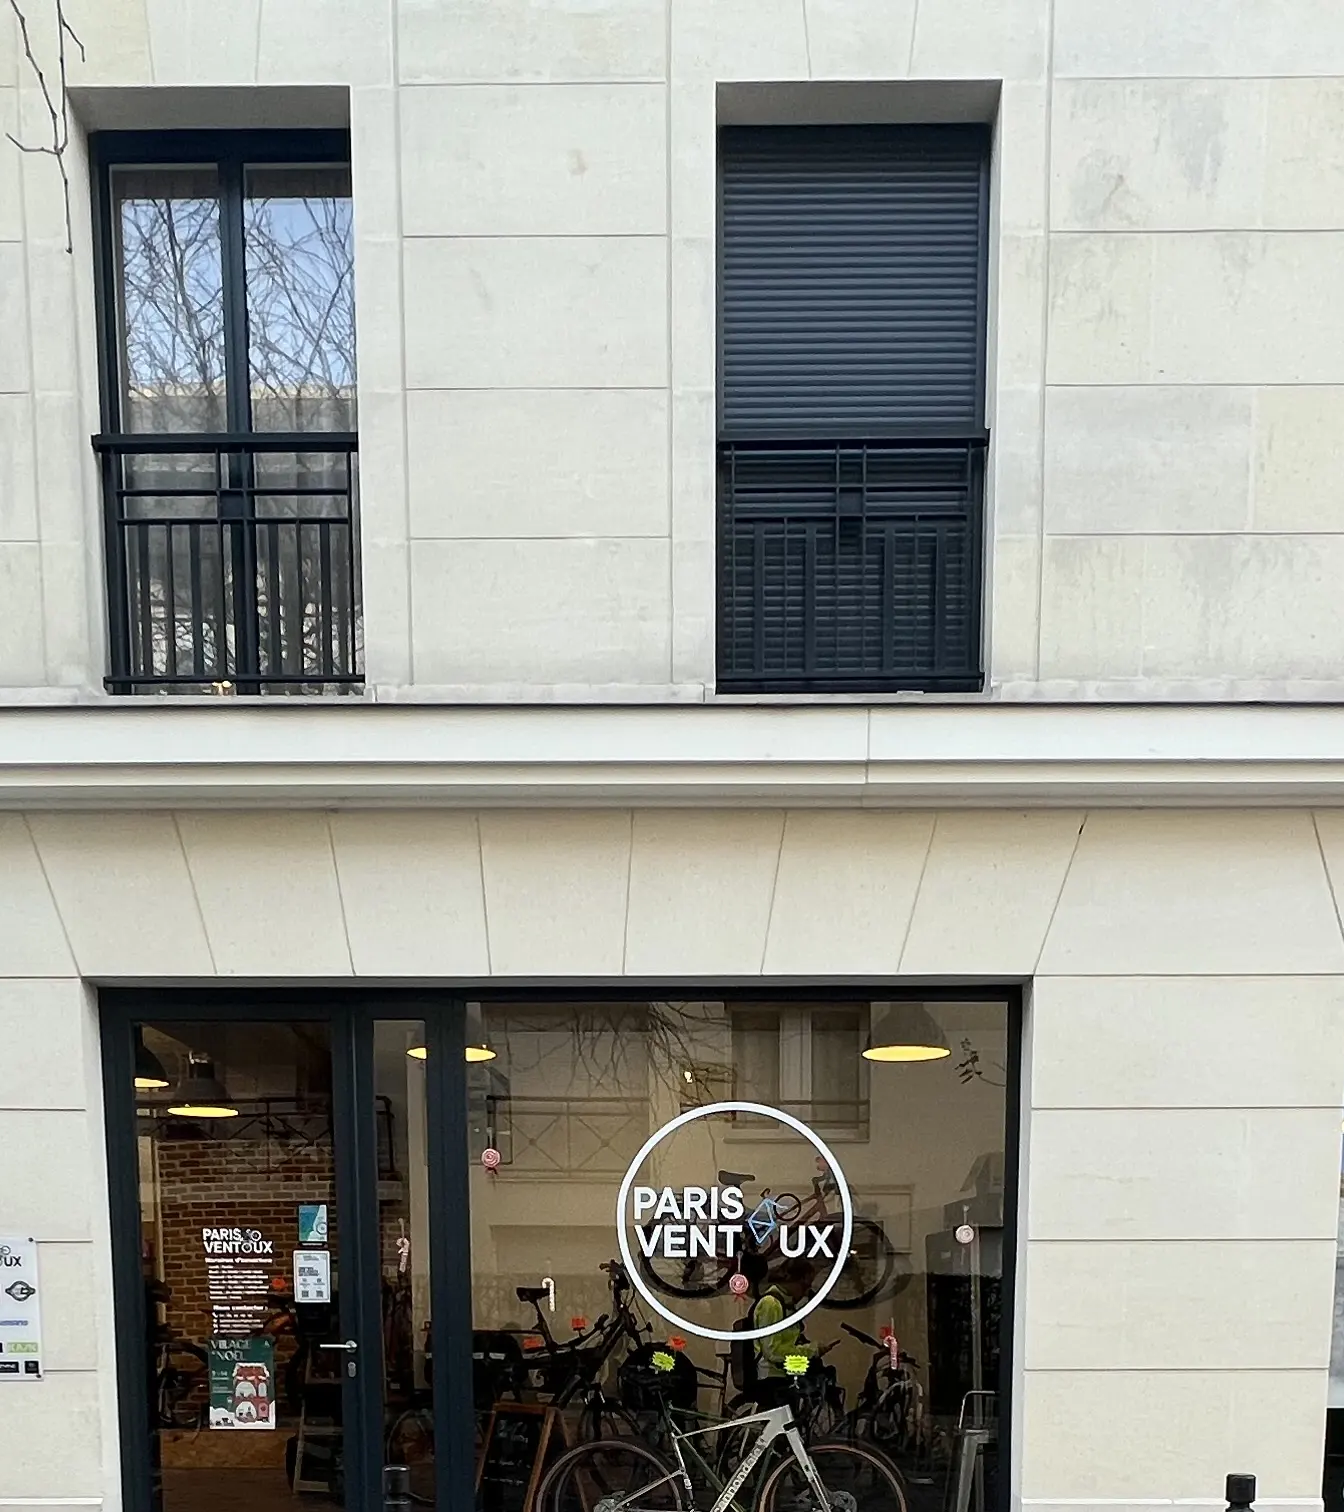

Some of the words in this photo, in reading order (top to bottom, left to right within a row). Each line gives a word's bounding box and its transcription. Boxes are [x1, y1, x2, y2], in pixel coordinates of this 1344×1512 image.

[633, 1185, 744, 1220] PARIS
[202, 1227, 242, 1241] PARIS
[633, 1224, 835, 1259] VENTUX
[203, 1240, 273, 1254] VENTOUX
